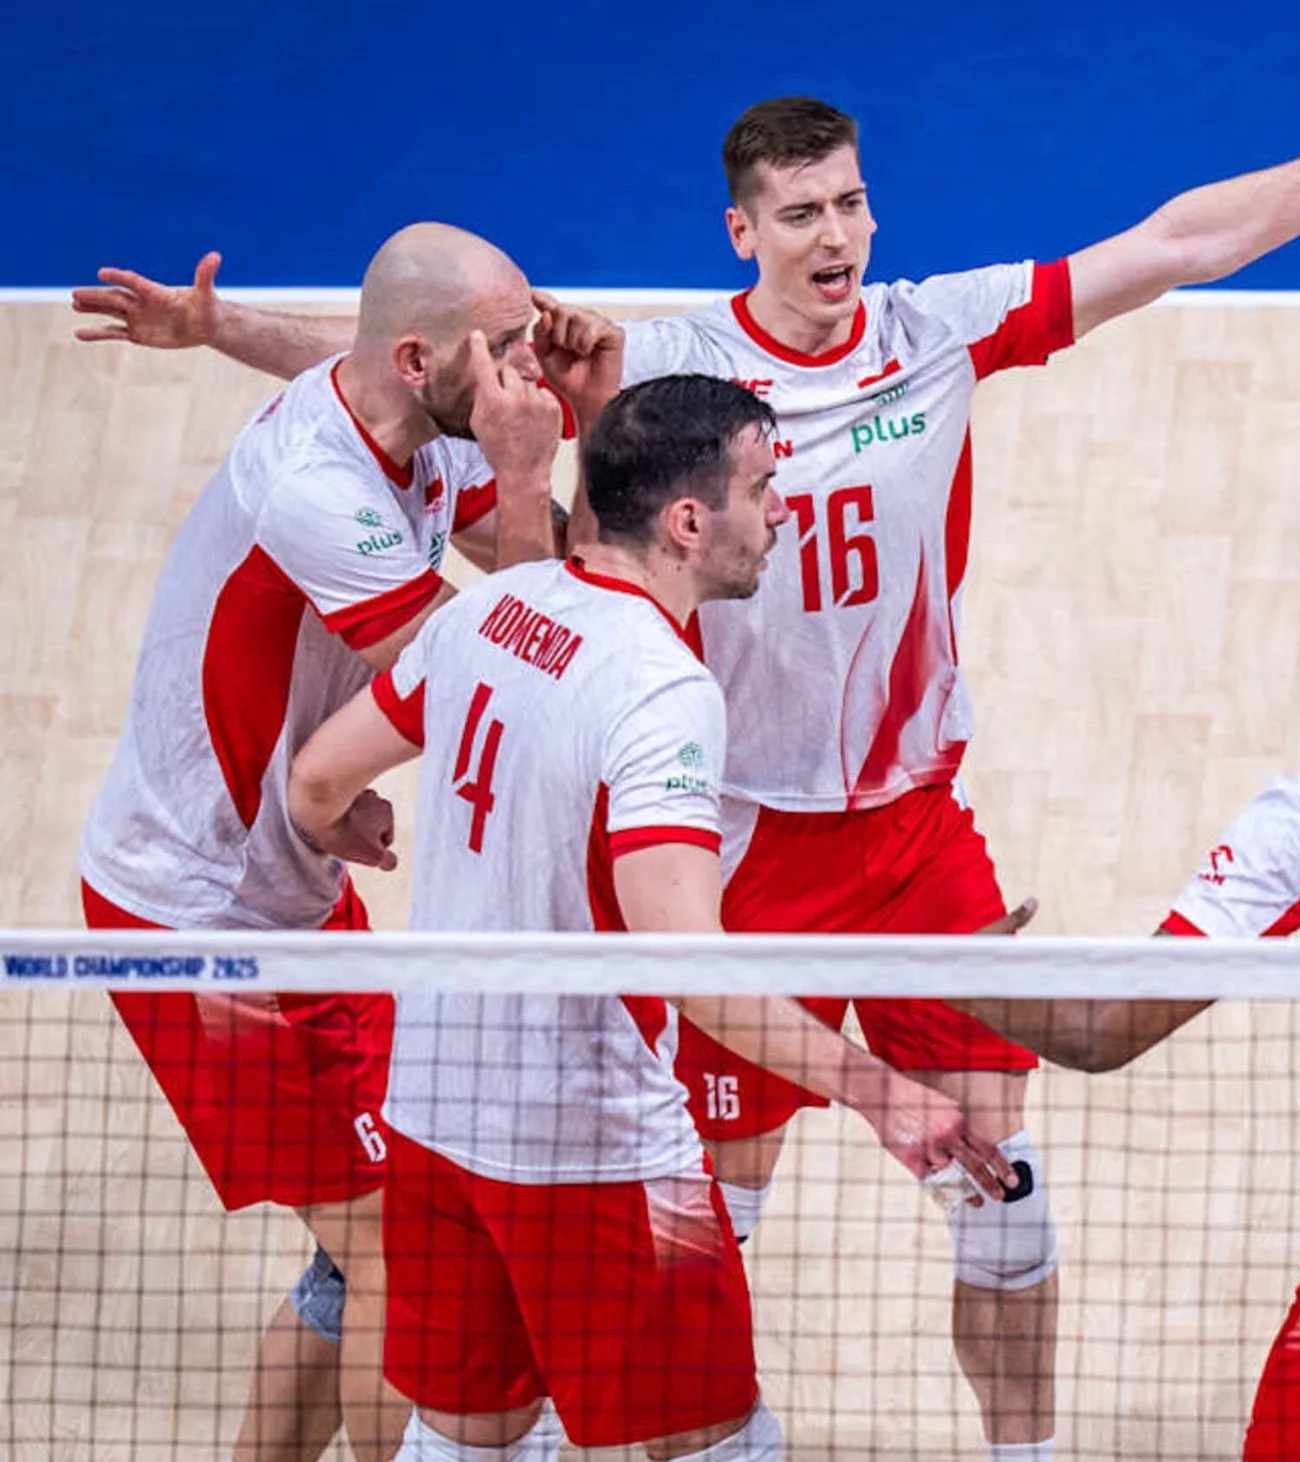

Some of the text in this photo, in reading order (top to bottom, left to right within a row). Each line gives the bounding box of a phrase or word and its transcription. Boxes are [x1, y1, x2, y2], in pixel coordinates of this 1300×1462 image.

[851, 411, 926, 454] plus
[357, 531, 404, 556] plus
[785, 484, 879, 613] 16
[478, 593, 583, 680] KOMENDA
[452, 682, 504, 855] 4
[3, 955, 259, 979] WORLD CHAMPIONSHIP 2025
[702, 1072, 741, 1120] 16
[353, 1111, 387, 1163] 6
